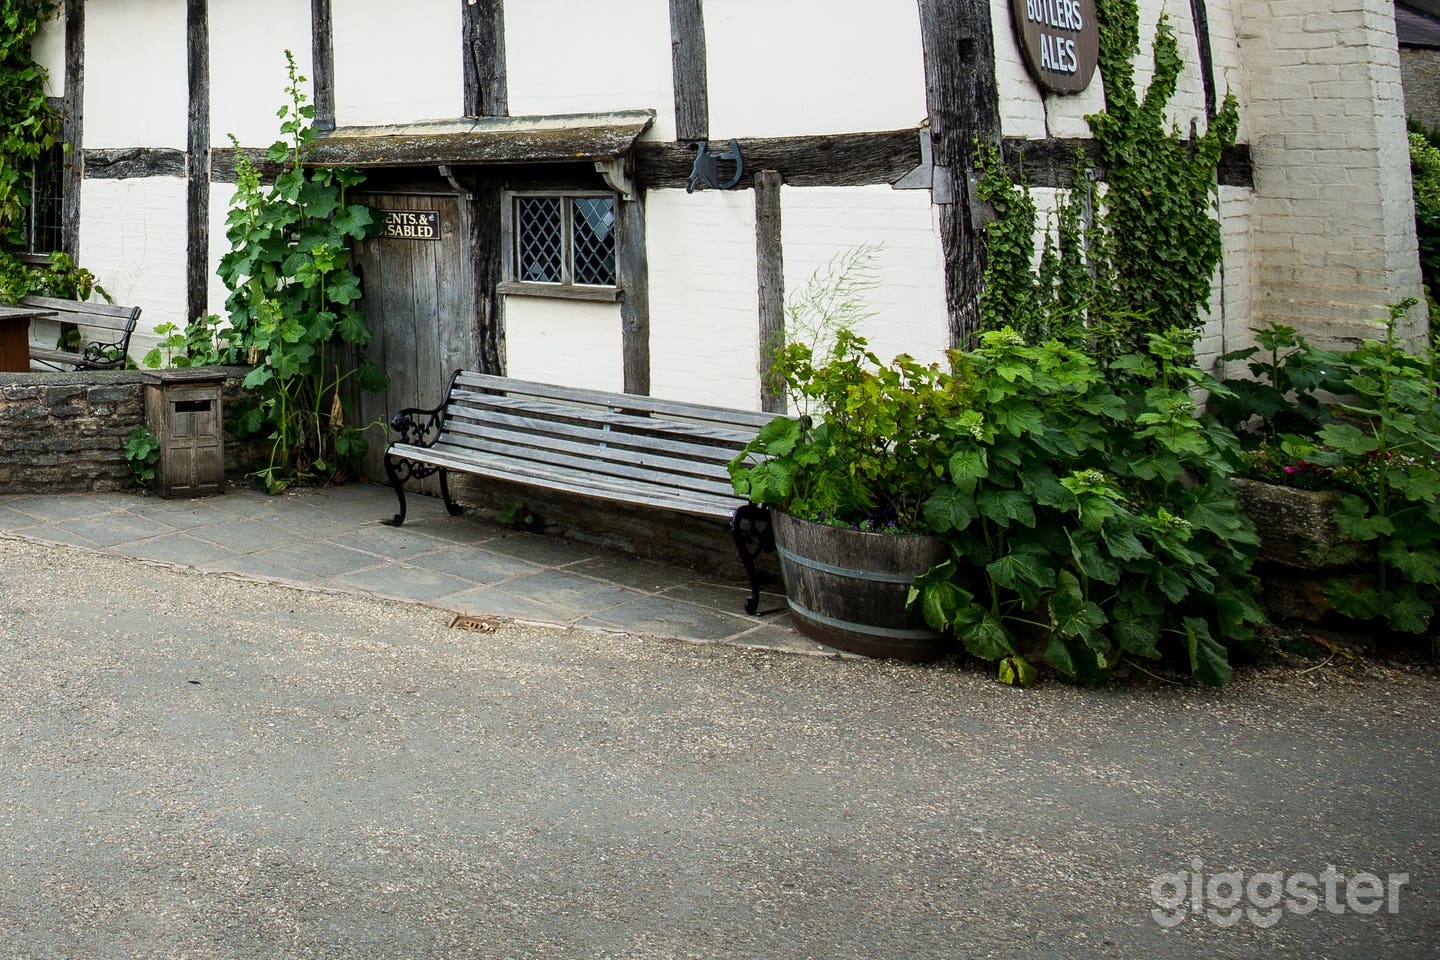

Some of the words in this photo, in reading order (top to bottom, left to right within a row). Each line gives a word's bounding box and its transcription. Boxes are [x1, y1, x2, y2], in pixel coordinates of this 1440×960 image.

[1040, 33, 1077, 73] ALES
[382, 213, 418, 225] ENTS.
[379, 225, 433, 237] SABLED
